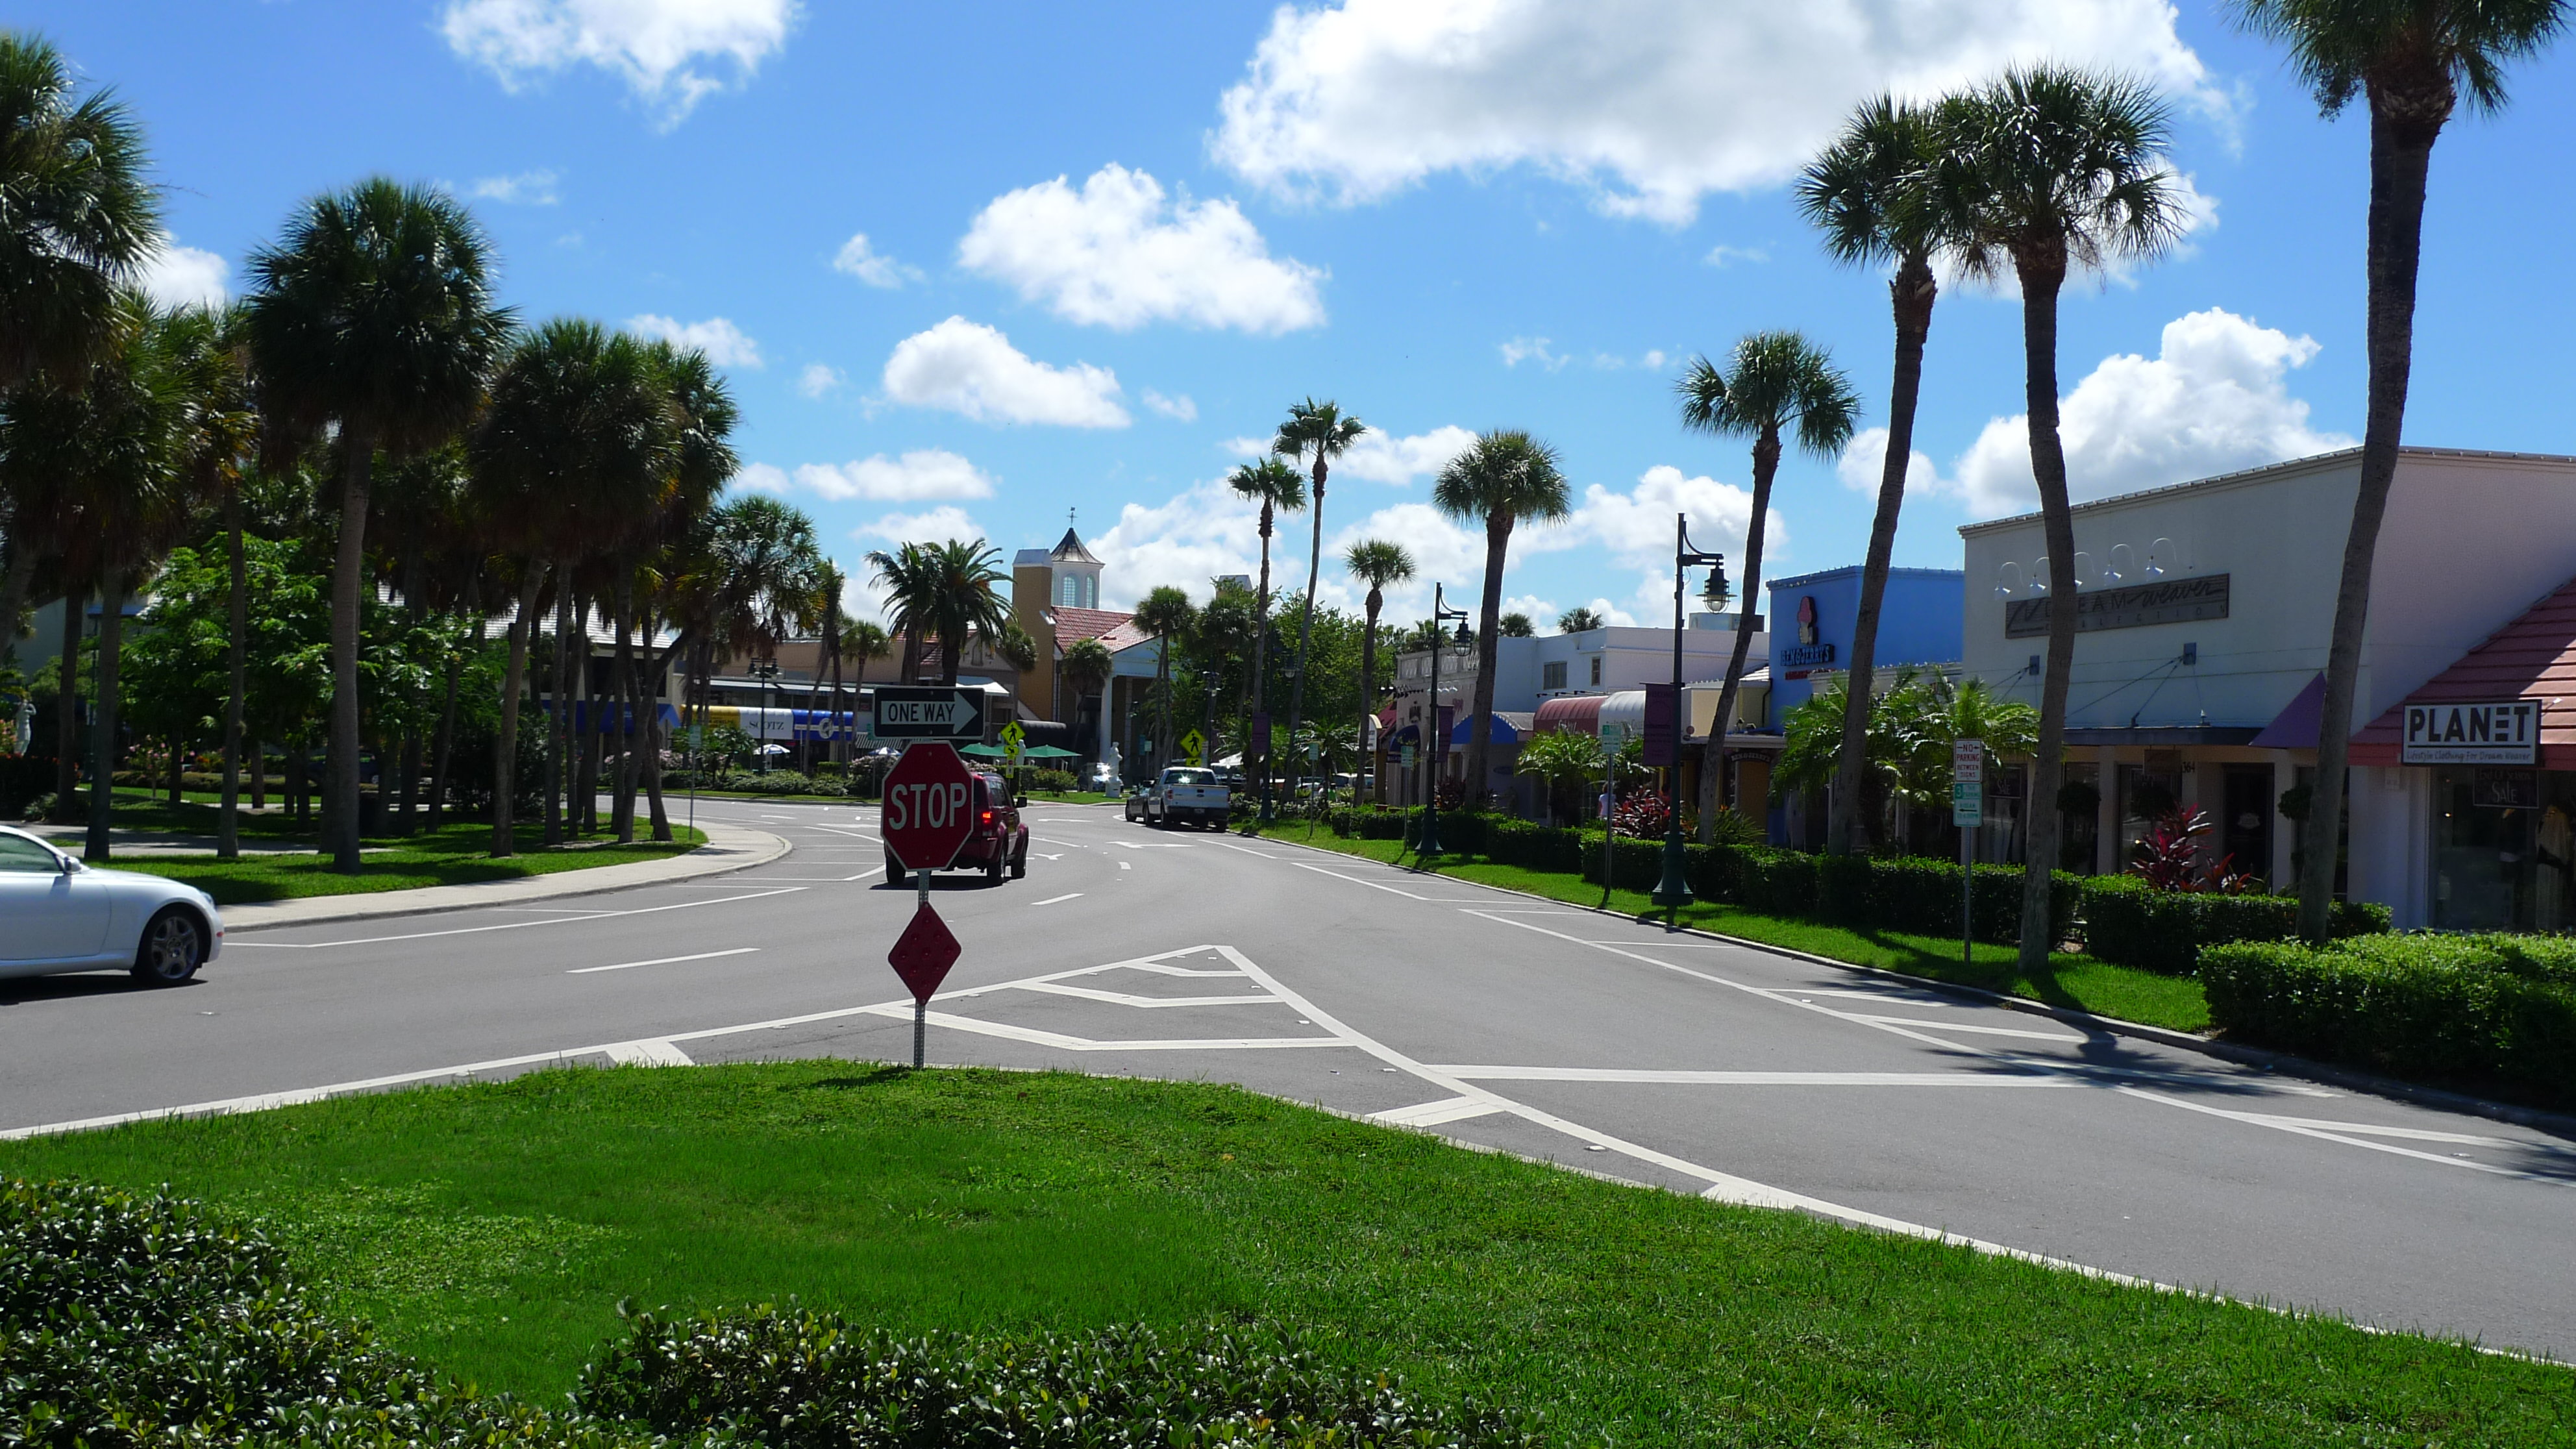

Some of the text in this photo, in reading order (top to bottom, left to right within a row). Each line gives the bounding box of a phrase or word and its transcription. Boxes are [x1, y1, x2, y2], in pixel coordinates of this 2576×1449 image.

[888, 703, 955, 722] ONE WAY
[2409, 706, 2530, 742] PLANET
[2434, 750, 2464, 762] Clothing
[1956, 786, 1962, 797] 3
[888, 782, 967, 830] STOP
